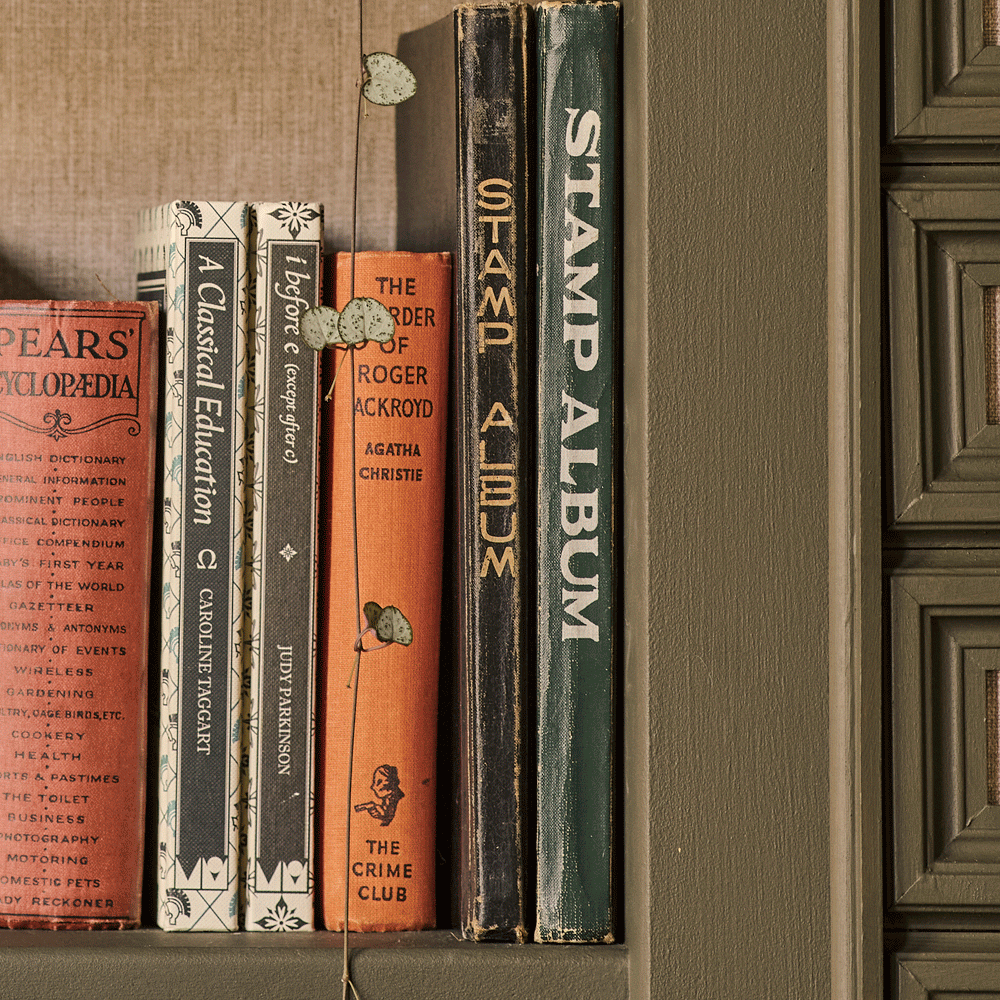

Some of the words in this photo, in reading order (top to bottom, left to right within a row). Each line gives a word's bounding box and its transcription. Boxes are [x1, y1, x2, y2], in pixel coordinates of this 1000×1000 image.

[564, 107, 601, 372] STAMP
[198, 255, 225, 274] A
[286, 255, 307, 265] i
[477, 178, 515, 353] STAMP
[375, 277, 416, 295] THE
[275, 270, 310, 335] before
[388, 306, 435, 327] RDER
[196, 281, 225, 389] Classical
[284, 342, 299, 354] e
[380, 337, 409, 354] OF
[358, 365, 427, 384] ROGER
[280, 363, 300, 412] (except
[354, 398, 433, 418] ACKROYD
[279, 414, 300, 448] after
[283, 450, 298, 464] c)
[365, 443, 421, 457] AGATHA
[50, 455, 126, 465] DICTIONARY
[193, 396, 225, 525] Education
[43, 476, 126, 486] INFORMATION
[359, 467, 422, 481] CHRISTIE
[479, 402, 515, 577] ALBUM
[73, 497, 125, 506] PEOPLE
[52, 517, 126, 527] DICTIONARY
[559, 390, 600, 643] ALBUM
[37, 538, 125, 548] COMPENDIUM
[39, 559, 80, 569] FIRST
[87, 561, 124, 570] YEAR
[26, 580, 42, 589] OF
[48, 581, 73, 590] THE
[78, 582, 124, 591] WORLD
[9, 602, 94, 612] GAZETTEER
[48, 622, 55, 631] &
[64, 624, 126, 633] ANTONYMS
[199, 588, 214, 672] CAROLINE
[52, 645, 68, 655] OF
[76, 646, 126, 656] EVENTS
[14, 665, 94, 677] WIRELESS
[277, 645, 293, 689] JUDY
[6, 687, 94, 698] GARDENING
[197, 675, 213, 756] TAGGART
[12, 730, 86, 740] COOKERY
[278, 690, 292, 775] PARKINSON
[15, 751, 81, 761] HEALTH
[35, 773, 44, 781] &
[51, 774, 120, 783] PASTIMES
[2, 793, 32, 802] THE
[38, 794, 90, 804] TOILET
[8, 813, 85, 824] BUSINESS
[366, 840, 400, 854] THE
[7, 854, 88, 865] MOTORING
[352, 863, 412, 878] CRIME
[67, 879, 101, 888] PETS
[358, 886, 407, 903] CLUB
[32, 897, 114, 908] RECKONER
